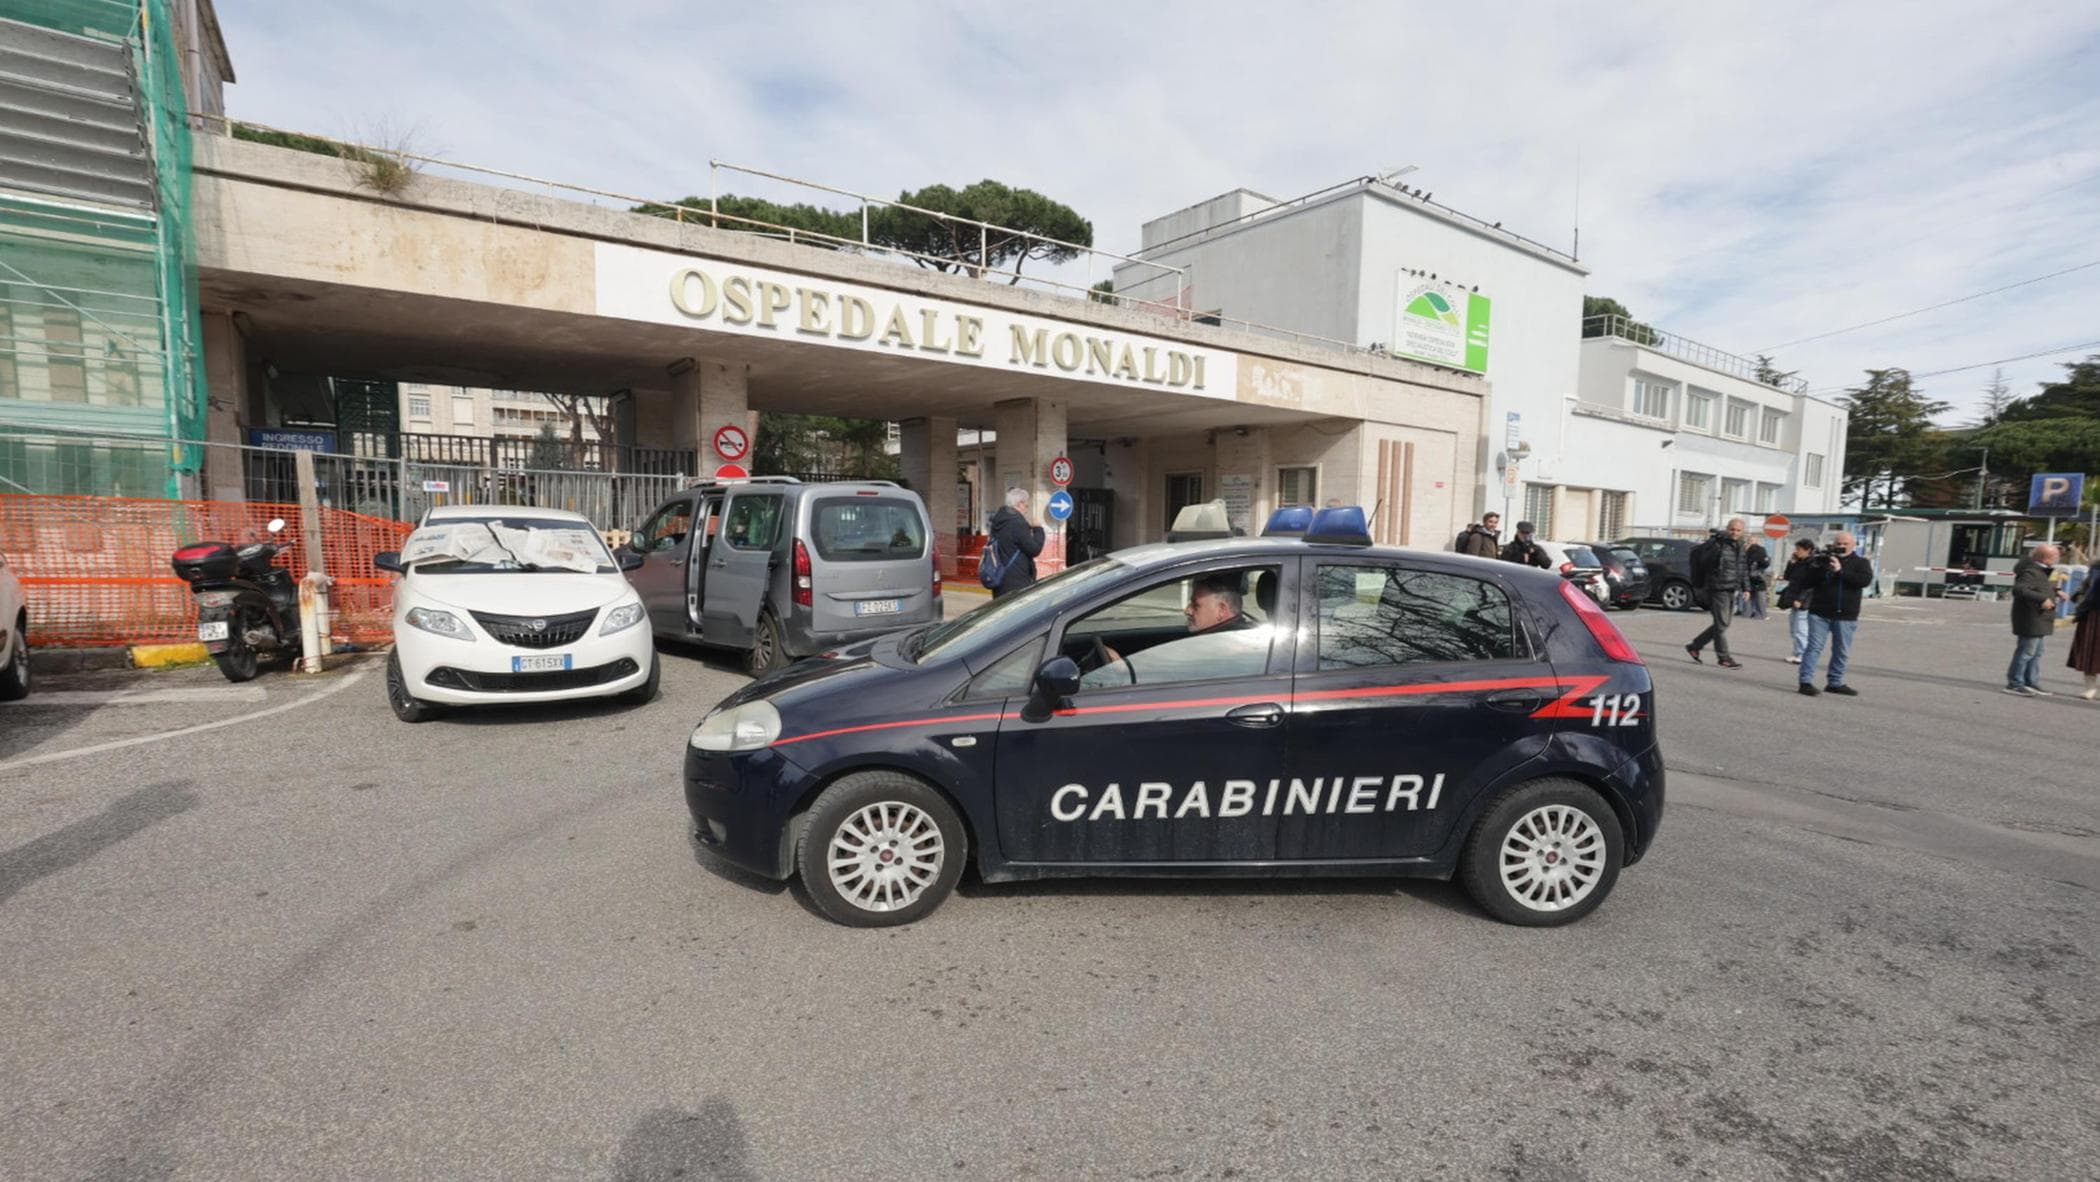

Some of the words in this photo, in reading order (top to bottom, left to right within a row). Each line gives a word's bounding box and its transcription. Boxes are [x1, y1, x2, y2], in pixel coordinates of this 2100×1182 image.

[669, 267, 986, 357] OSPEDALE
[1009, 323, 1206, 390] MONALDI
[262, 432, 324, 445] INGRESSO
[2043, 478, 2069, 503] P
[1589, 692, 1640, 727] 112
[1050, 773, 1445, 821] CARABINIERI
